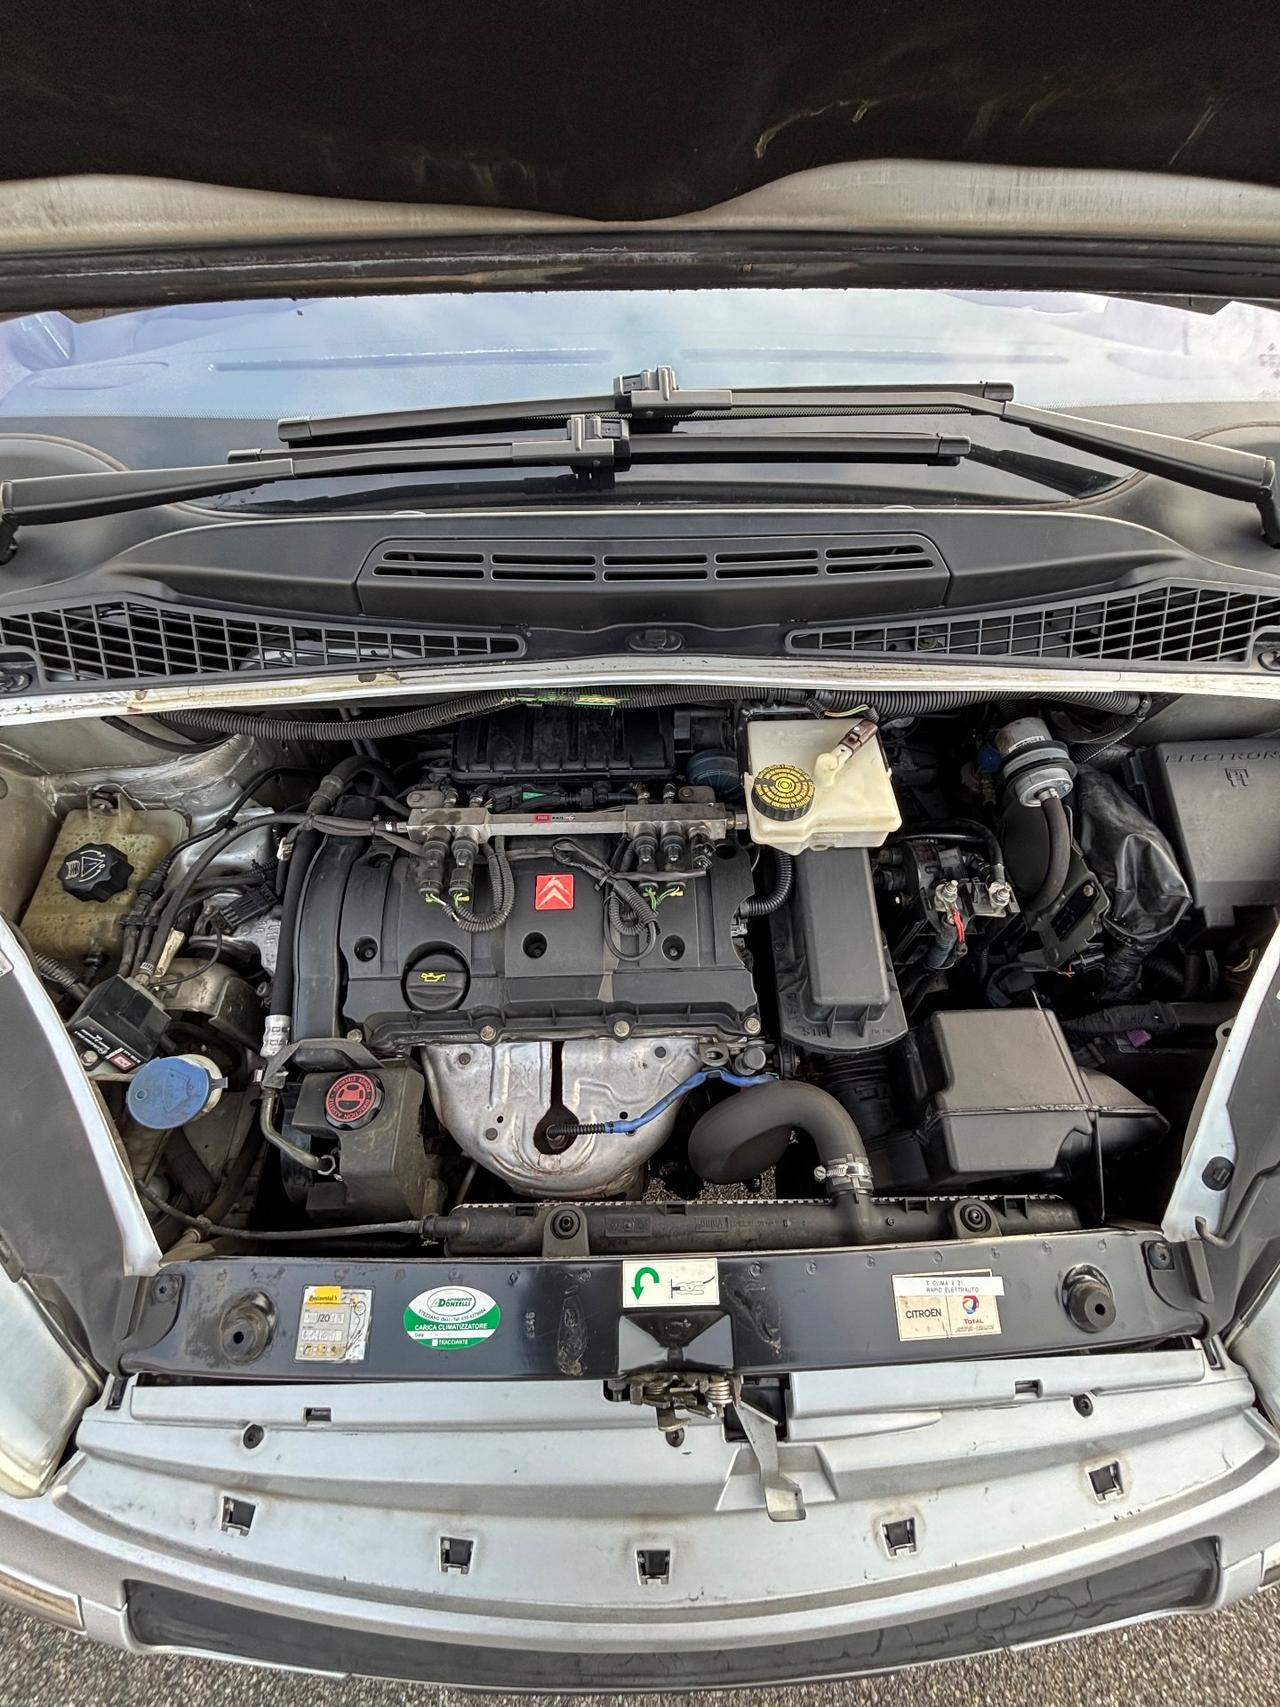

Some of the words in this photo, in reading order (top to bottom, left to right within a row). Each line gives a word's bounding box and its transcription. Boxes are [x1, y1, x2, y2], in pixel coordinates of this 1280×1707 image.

[438, 1299, 471, 1307] DONZELLI
[905, 1308, 942, 1319] CITROËN
[438, 1323, 488, 1331] CLIMATIZZATORE
